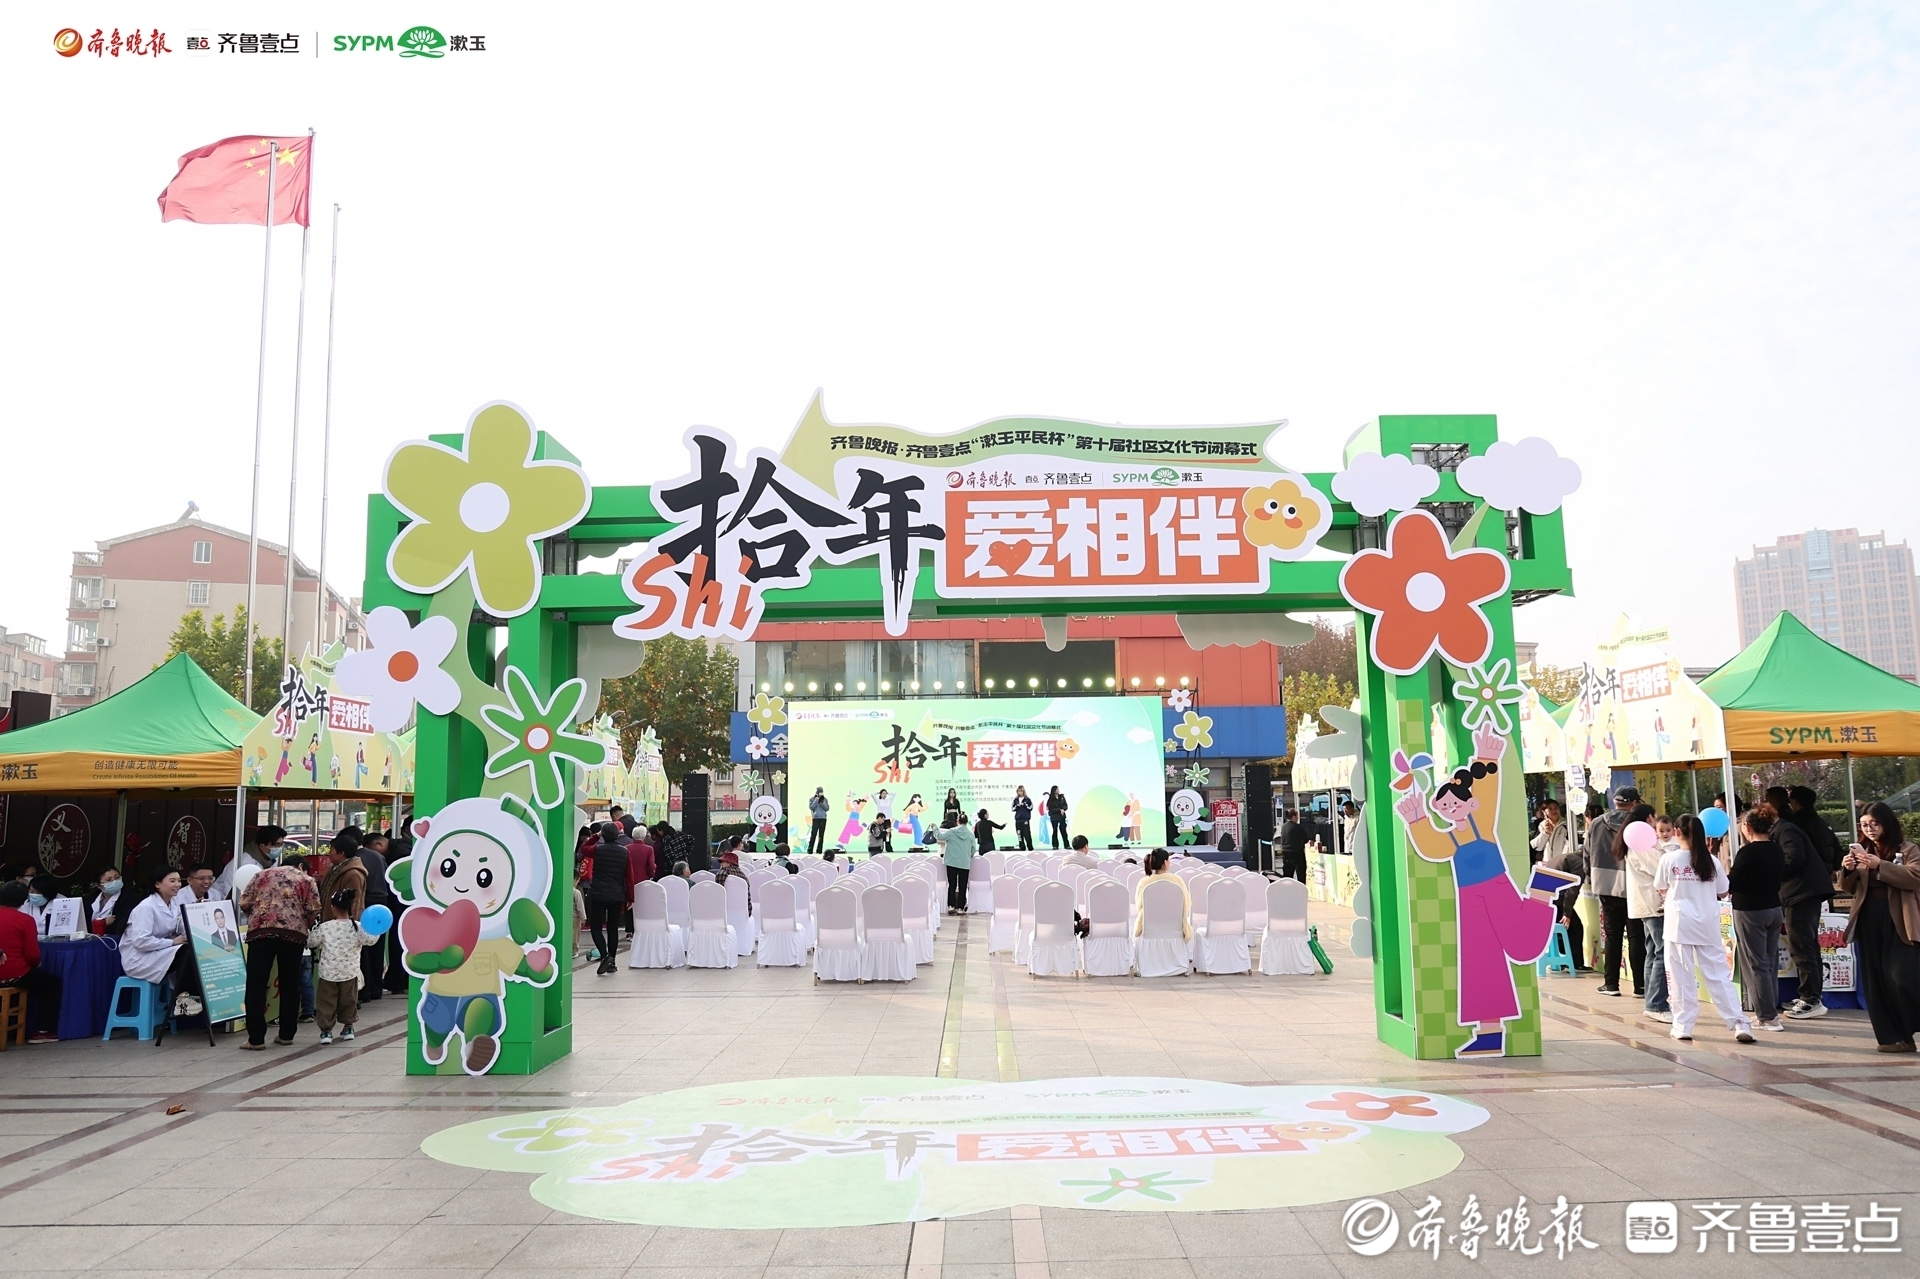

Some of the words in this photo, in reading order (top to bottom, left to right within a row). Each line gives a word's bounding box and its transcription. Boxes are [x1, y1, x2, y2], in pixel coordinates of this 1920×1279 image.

[1043, 472, 1092, 485] 齐鲁壹点
[1112, 473, 1149, 483] SYPM
[1181, 472, 1203, 483] 漱玉
[658, 435, 946, 624] 拾年
[964, 496, 1241, 579] 爱相伴
[281, 667, 330, 725] 拾年
[94, 760, 179, 770] 创造健康无限可能
[882, 724, 967, 777] 拾年
[973, 743, 1056, 768] 爱相伴
[641, 1124, 957, 1178] 拾年
[978, 1125, 1281, 1160] 爱相伴
